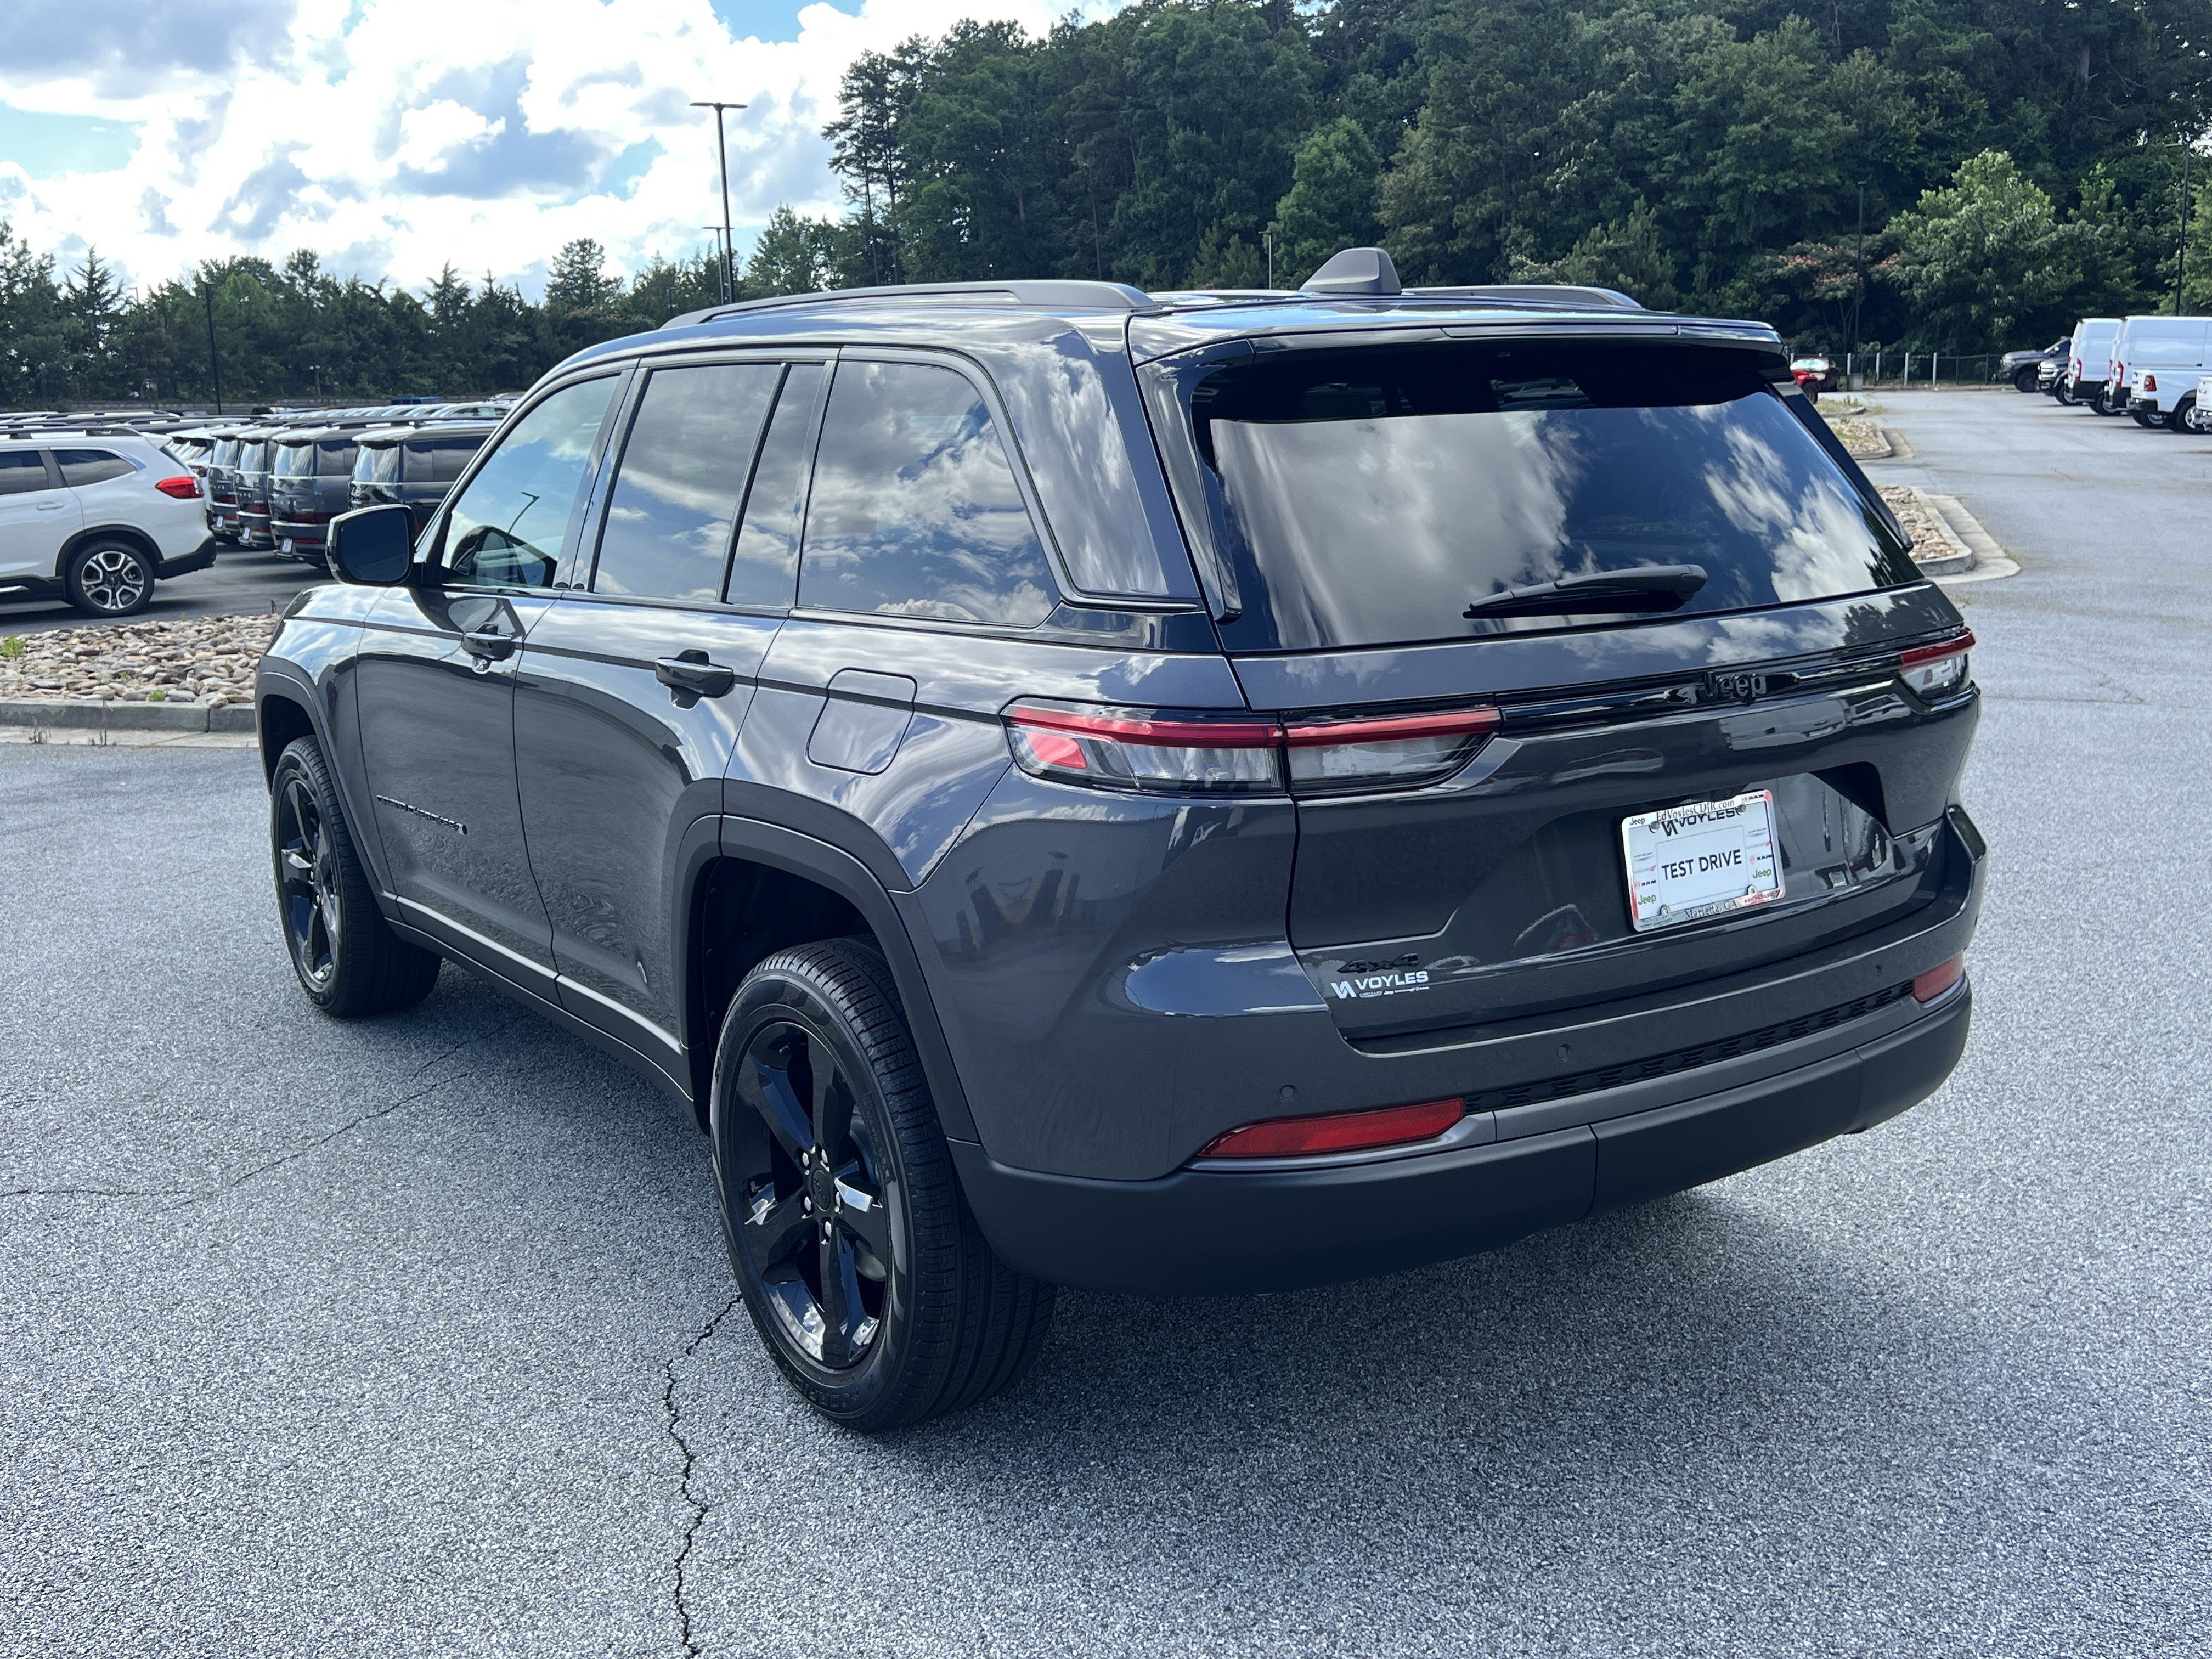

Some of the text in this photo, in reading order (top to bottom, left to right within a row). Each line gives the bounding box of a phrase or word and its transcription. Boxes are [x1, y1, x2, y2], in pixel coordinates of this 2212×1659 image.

[1697, 670, 1767, 706] Jeep
[1629, 816, 1646, 826] Jeep
[1661, 849, 1742, 881] TEST DRIVE
[1752, 867, 1772, 878] Jeep
[1638, 894, 1656, 905] Jeep
[1354, 970, 1429, 991] VOYLES
